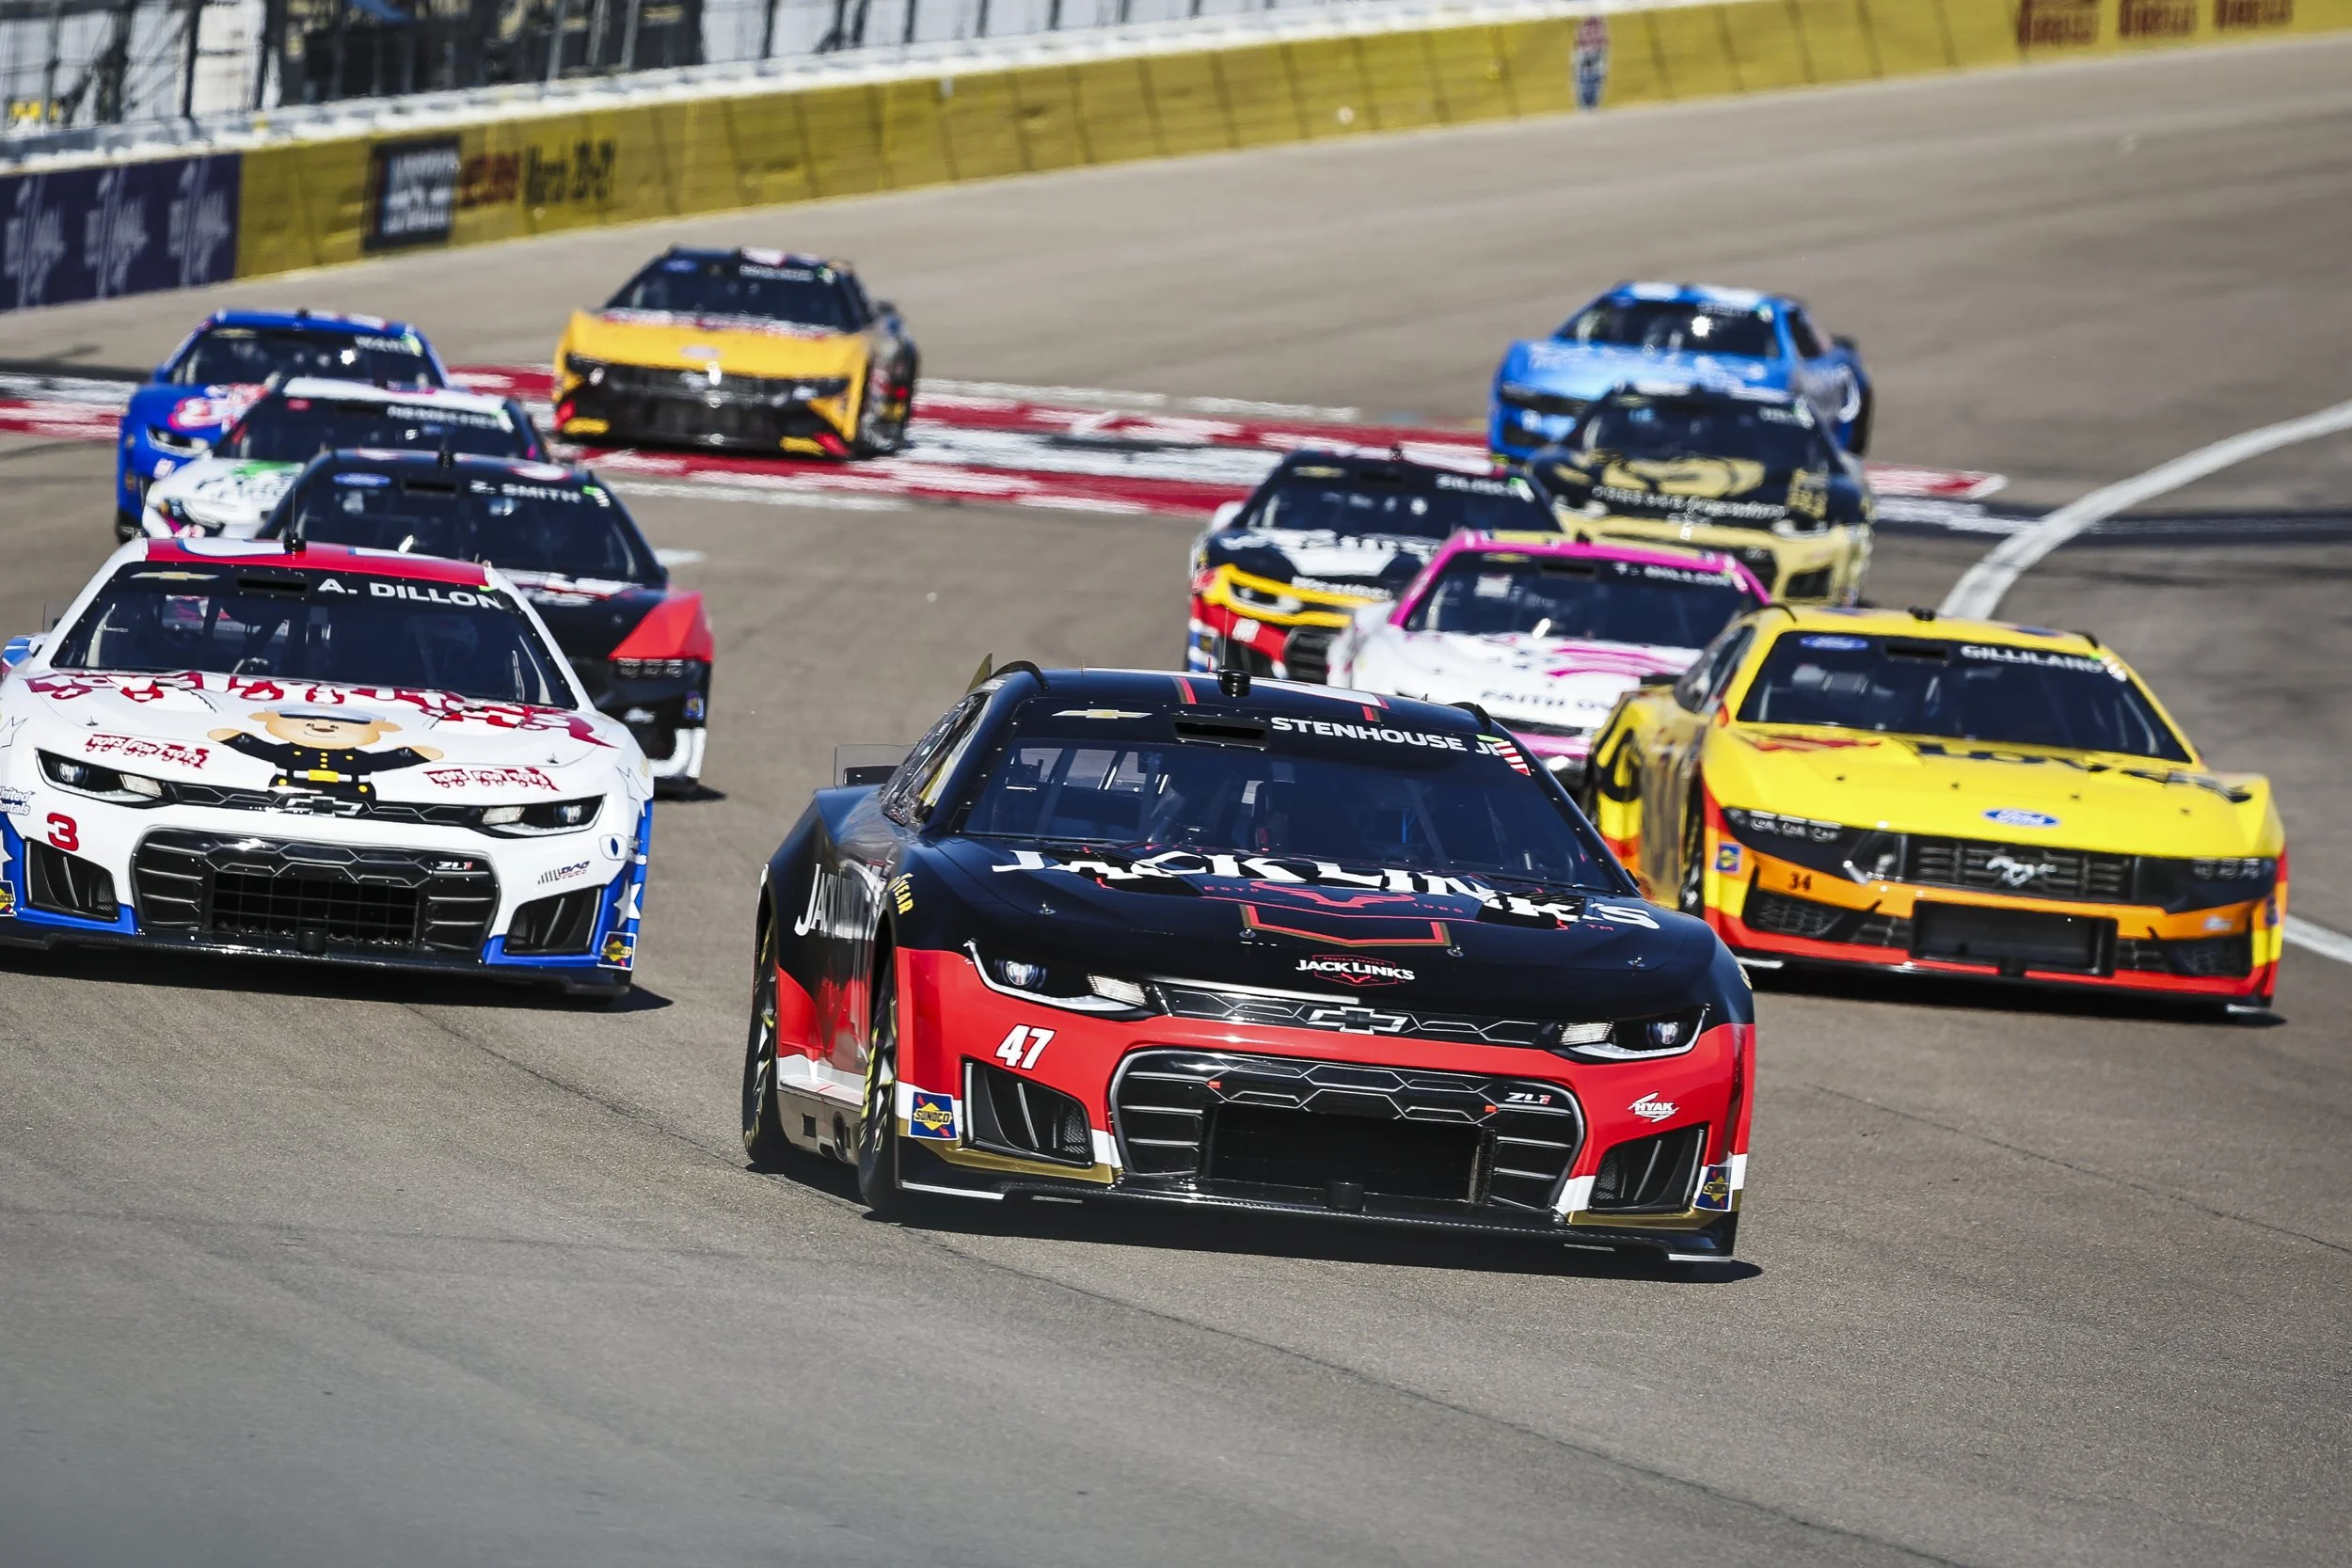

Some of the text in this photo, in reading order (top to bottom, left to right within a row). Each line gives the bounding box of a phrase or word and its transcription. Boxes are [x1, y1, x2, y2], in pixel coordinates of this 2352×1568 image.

[501, 483, 581, 504] SMITH
[317, 578, 358, 594] A.
[369, 581, 504, 610] DILLON
[1961, 645, 2105, 674] GILLILAND
[1271, 717, 1469, 752] STENHOUSE
[47, 812, 80, 852] 3
[436, 861, 473, 871] ZL1
[1789, 871, 1812, 891] 34
[994, 1023, 1057, 1070] 47
[1505, 1092, 1552, 1104] ZL1
[1635, 1101, 1675, 1112] HYAK
[914, 1108, 951, 1123] SUNOCO
